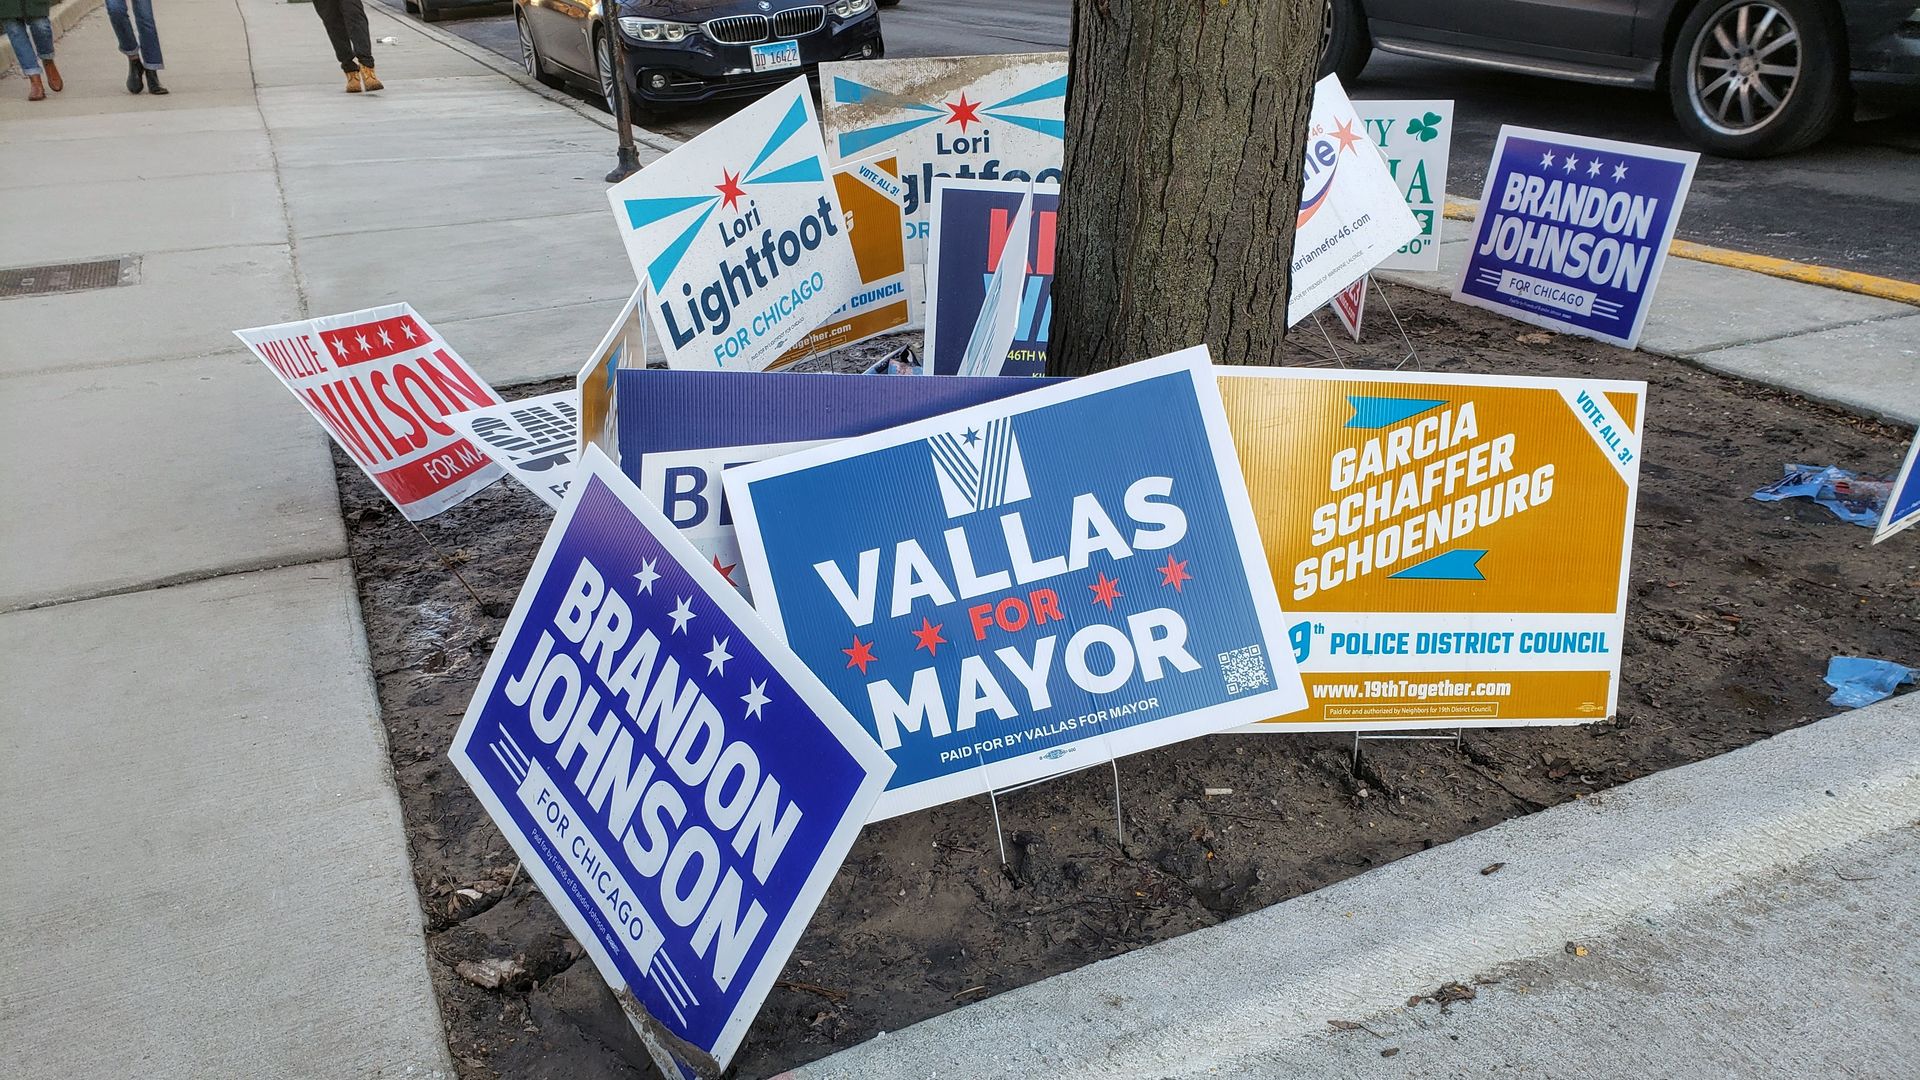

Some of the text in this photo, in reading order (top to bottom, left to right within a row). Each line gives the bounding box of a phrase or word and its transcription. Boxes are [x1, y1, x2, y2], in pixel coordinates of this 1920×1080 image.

[771, 49, 798, 64] 16422
[937, 130, 989, 155] Lori
[858, 165, 900, 197] VOTE ALL 3!
[1500, 172, 1659, 239] BRANDON
[719, 200, 761, 248] Lori
[1479, 213, 1654, 293] JOHNSON
[660, 195, 839, 351] Lightfoot
[851, 282, 905, 309] COUNCIL
[1509, 277, 1584, 307] FOR CHICAGO
[713, 327, 751, 367] FOR
[752, 271, 824, 337] CHICAGO
[256, 335, 328, 380] WILLIE
[1007, 350, 1035, 362] 46TH
[294, 348, 498, 466] WILSON
[1576, 389, 1633, 466] VOTE ALL 3!
[423, 454, 463, 485] FOR
[1330, 400, 1479, 492] GARCIA
[1311, 433, 1516, 547] SCHAFFER
[814, 476, 1187, 627] VALLAS
[1293, 464, 1555, 601] SCHOENBURG
[968, 588, 1064, 641] FOR
[1289, 620, 1609, 664] 9th POLICE DISTRICT COUNCIL
[866, 606, 1202, 751] MAYOR
[1313, 680, 1512, 700] www.19thTogether.com
[1343, 707, 1351, 715] for
[1393, 707, 1401, 716] by
[1401, 706, 1428, 715] Neighbors
[1451, 705, 1470, 713] District
[554, 556, 803, 885] BRANDON
[940, 697, 1159, 763] PAID FOR BY VALLAS FOR MAYOR
[505, 629, 767, 992] JOHNSON
[531, 828, 543, 844] Paid
[546, 849, 553, 861] by
[552, 856, 568, 881] Friends
[566, 878, 574, 887] of
[571, 883, 590, 911] Brandon
[588, 907, 606, 935] Johnson
[537, 790, 645, 941] FOR CHICAGO
